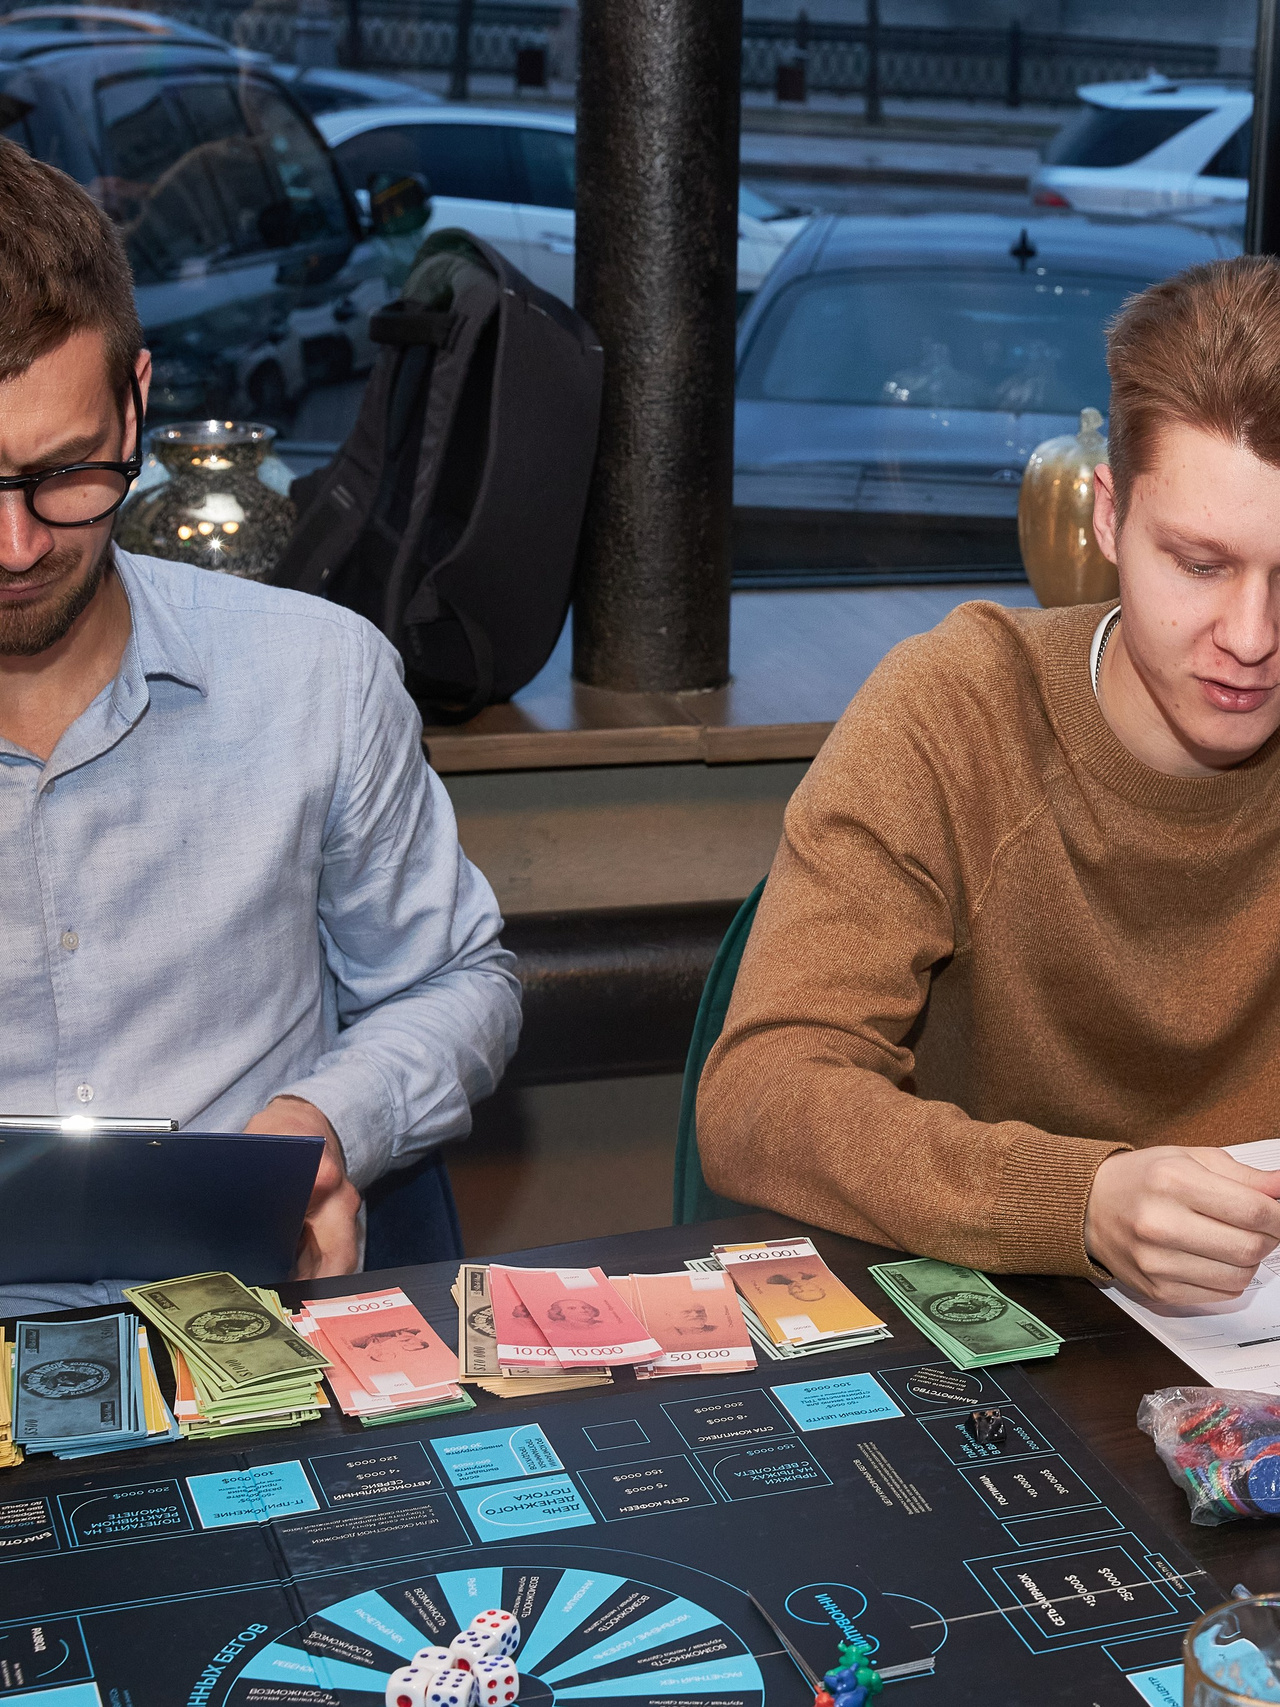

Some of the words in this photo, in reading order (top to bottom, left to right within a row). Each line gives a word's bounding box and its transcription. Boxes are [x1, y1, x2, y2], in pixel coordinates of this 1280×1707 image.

[738, 1251, 771, 1261] 000
[771, 1248, 801, 1258] 100
[347, 1301, 380, 1313] 000
[382, 1299, 394, 1308] 5
[513, 1346, 530, 1356] 10
[536, 1347, 556, 1357] 00
[568, 1348, 588, 1358] 10
[590, 1345, 624, 1357] 000
[669, 1352, 692, 1362] 50
[696, 1349, 731, 1360] 000
[912, 1386, 979, 1405] БАНКРОТСТВО
[693, 1404, 722, 1414] 000$
[722, 1401, 744, 1409] 200
[838, 1405, 891, 1418] ТОРГОВЫЙ
[805, 1413, 837, 1424] ЦЕНТР
[696, 1429, 752, 1443] КОМПЛЕКС
[752, 1425, 775, 1435] СПА
[746, 1446, 775, 1457] 000$
[776, 1443, 796, 1451] 150
[346, 1458, 377, 1468] 000$
[252, 1470, 275, 1478] 100
[356, 1469, 387, 1480] 000$
[643, 1468, 664, 1476] 150
[733, 1462, 798, 1478] ВЕРТОЛЕТА
[749, 1469, 796, 1482] ЛЫЖАХ
[796, 1466, 815, 1476] НА
[612, 1472, 643, 1482] 000$
[764, 1472, 819, 1486] ПРЫЖКИ
[1012, 1472, 1032, 1491] 000$
[1039, 1467, 1060, 1487] 000$
[147, 1485, 170, 1495] 200
[333, 1479, 432, 1501] АВТОМОБИЛЬНЫЙ
[360, 1478, 404, 1490] СЕРВИС
[624, 1484, 654, 1495] 000$
[979, 1474, 1010, 1507] ГОСТИНИЦА
[112, 1489, 144, 1500] 000$
[513, 1486, 571, 1501] ПОТОКА
[485, 1494, 577, 1516] ДЕНЕЖНОГО
[619, 1500, 662, 1513] КОФЕЕН
[663, 1495, 691, 1506] СЕТЬ
[107, 1505, 178, 1521] САМОЛЕТЕ
[542, 1502, 581, 1516] ДЕНЬ
[91, 1511, 179, 1529] РЕАКТИВНОМ
[102, 1517, 181, 1534] ПОЛЕТАЙТЕ
[415, 1518, 439, 1527] ЦЕЛИ
[82, 1528, 101, 1537] НА
[356, 1522, 415, 1537] СКОРОСТНОЙ
[311, 1532, 356, 1545] ДОРОЖКИ
[1097, 1566, 1122, 1589] 000$
[1016, 1571, 1052, 1610] ЗАПРАВОК
[1064, 1573, 1088, 1596] 000$
[521, 1576, 540, 1618] ВОЗМОЖНОСТЬ
[1117, 1586, 1135, 1602] 250
[413, 1587, 447, 1628] ВОЗМОЖНОСТЬ
[597, 1594, 650, 1634] ВОЗМОЖНОСТЬ
[1047, 1608, 1066, 1627] СЕТЬ
[213, 1623, 268, 1663] БЕГОВ
[308, 1630, 373, 1658] ВОЗМОЖНОСТЬ
[650, 1642, 728, 1667] ВОЗМОЖНОСТЬ
[249, 1687, 333, 1701] ВОЗМОЖНОСТЬ
